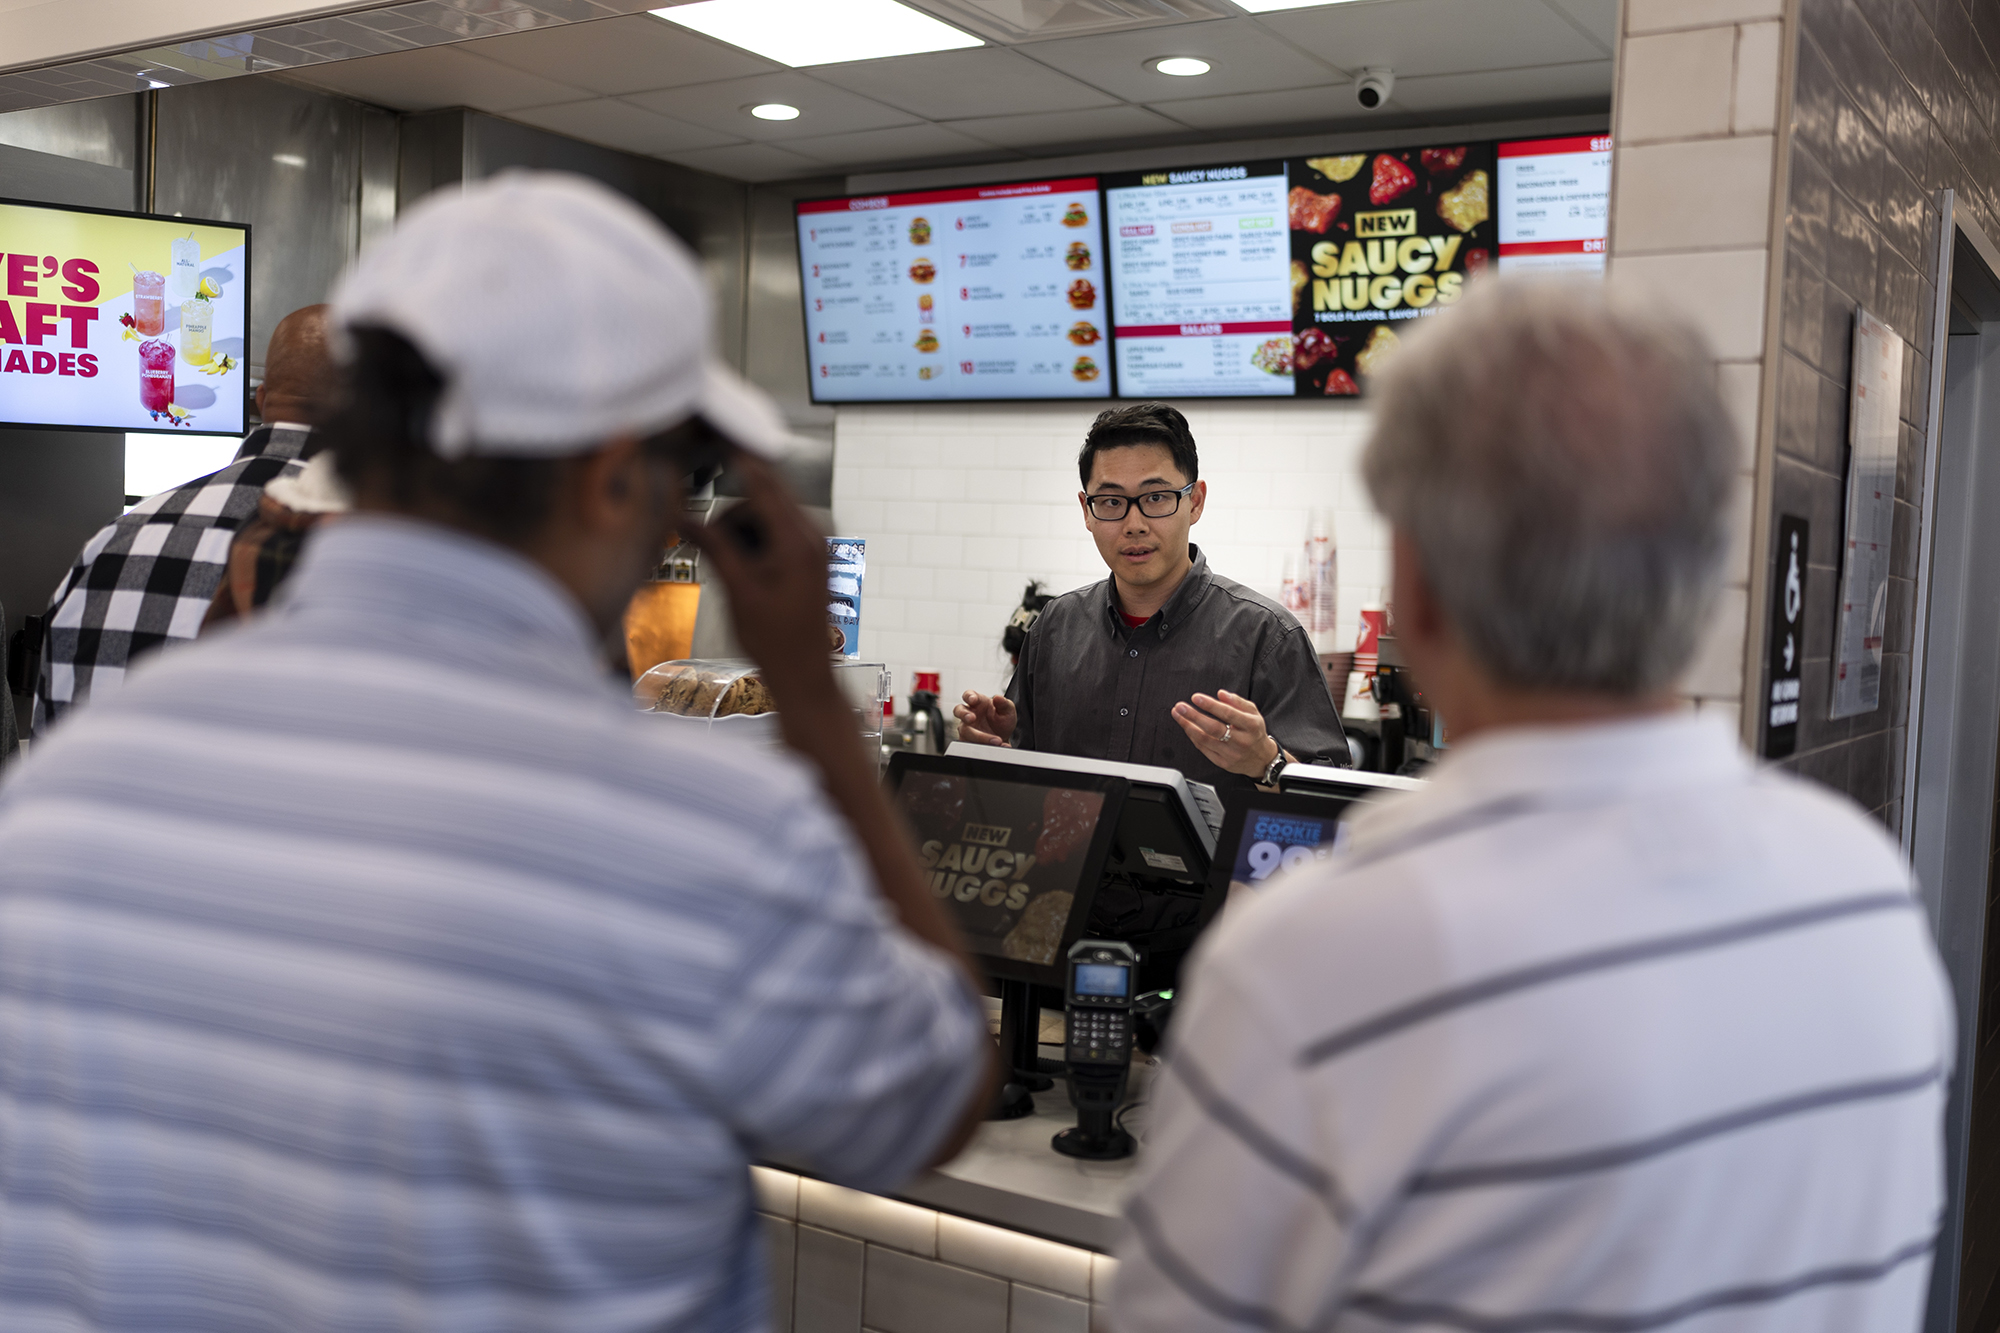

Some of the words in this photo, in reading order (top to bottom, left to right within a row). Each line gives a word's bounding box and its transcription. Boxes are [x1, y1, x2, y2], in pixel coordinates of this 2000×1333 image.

[1142, 173, 1168, 187] NEW
[1169, 169, 1204, 185] SAUCY
[1206, 166, 1248, 182] NUGGS
[849, 196, 889, 212] COMBOS
[955, 217, 964, 231] 6
[1361, 214, 1410, 234] NEW
[958, 254, 967, 268] 7
[1311, 235, 1463, 278] SAUCY
[0, 252, 100, 303] E'S
[811, 264, 820, 277] 2
[960, 287, 969, 300] 8
[1312, 272, 1463, 311] NUGGS
[815, 298, 823, 312] 3
[1321, 311, 1345, 323] BOLD
[1388, 308, 1418, 320] SAVOR
[962, 325, 971, 338] 9
[1180, 323, 1223, 336] SALADS
[818, 332, 826, 343] 4
[0, 348, 98, 378] ADES
[960, 361, 974, 374] 10
[820, 365, 828, 378] 5
[851, 542, 865, 556] $5
[844, 616, 860, 626] DAY
[966, 825, 1007, 844] NEW
[1255, 821, 1322, 841] COOKIE
[921, 839, 1036, 880] SAUCY
[925, 870, 1030, 910] UGGS
